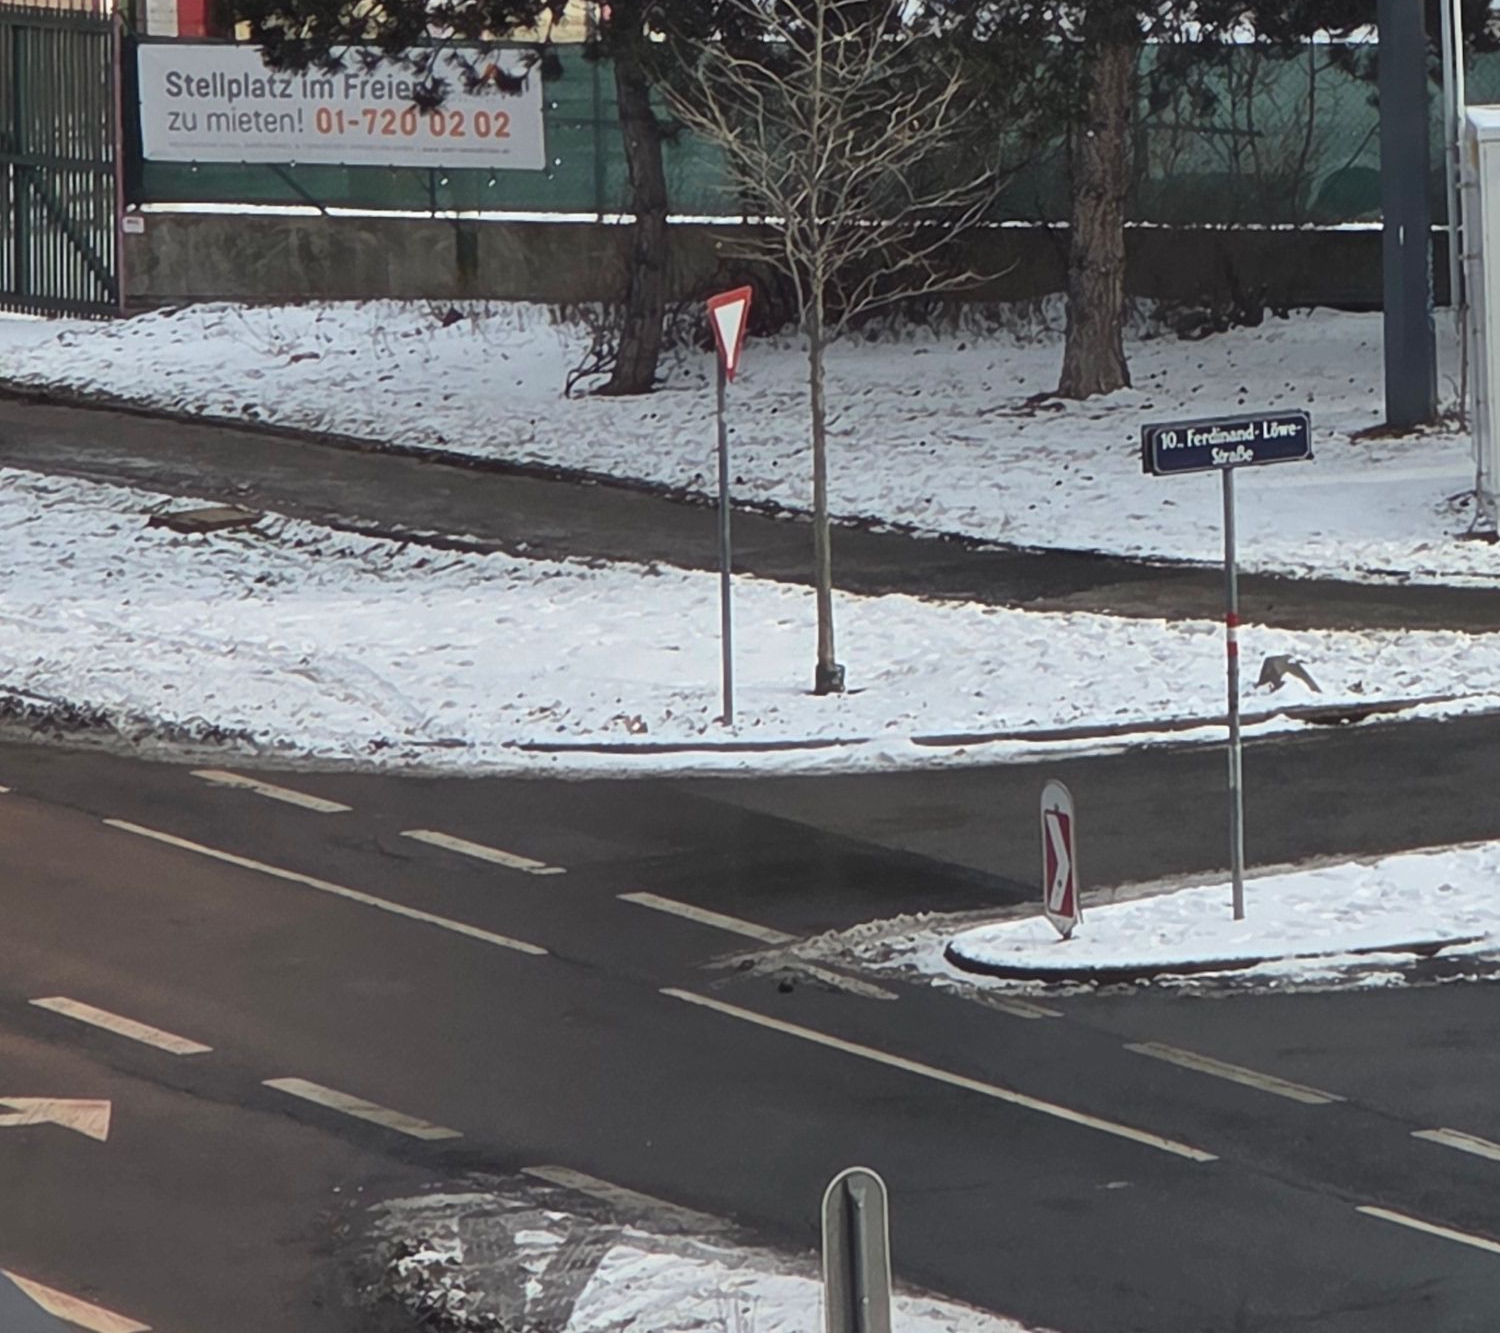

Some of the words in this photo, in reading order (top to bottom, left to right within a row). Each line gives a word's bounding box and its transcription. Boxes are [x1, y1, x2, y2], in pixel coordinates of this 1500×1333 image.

[165, 71, 292, 104] Stellplatz
[302, 74, 334, 99] im
[168, 111, 197, 133] zu
[207, 107, 304, 134] mieten!
[316, 107, 417, 136] 01-720
[430, 109, 466, 137] 02
[474, 110, 511, 138] 02
[1211, 444, 1253, 465] Straße
